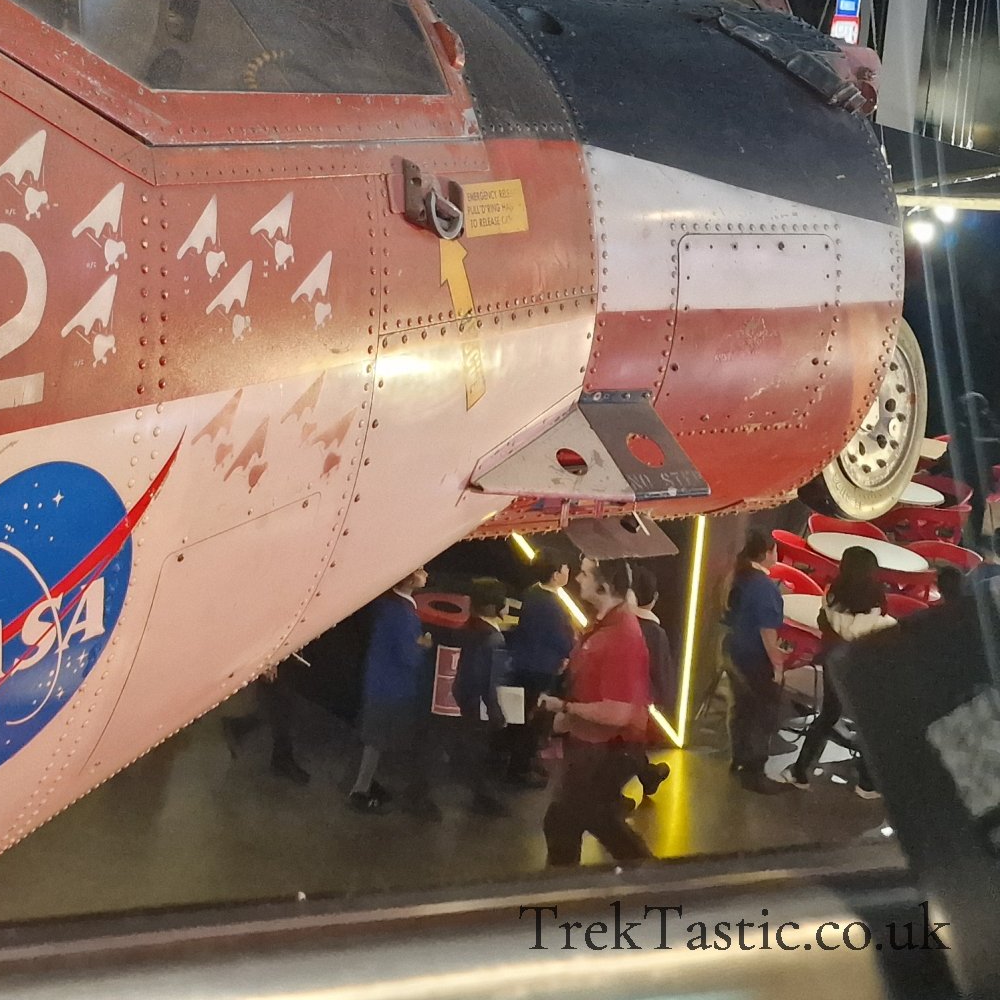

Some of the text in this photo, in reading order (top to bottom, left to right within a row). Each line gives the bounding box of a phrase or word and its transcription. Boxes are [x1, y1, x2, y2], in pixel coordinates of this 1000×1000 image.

[466, 190, 497, 202] EMERGENCY
[470, 218, 478, 229] TO
[479, 215, 501, 227] RELEASE
[627, 473, 652, 490] NO
